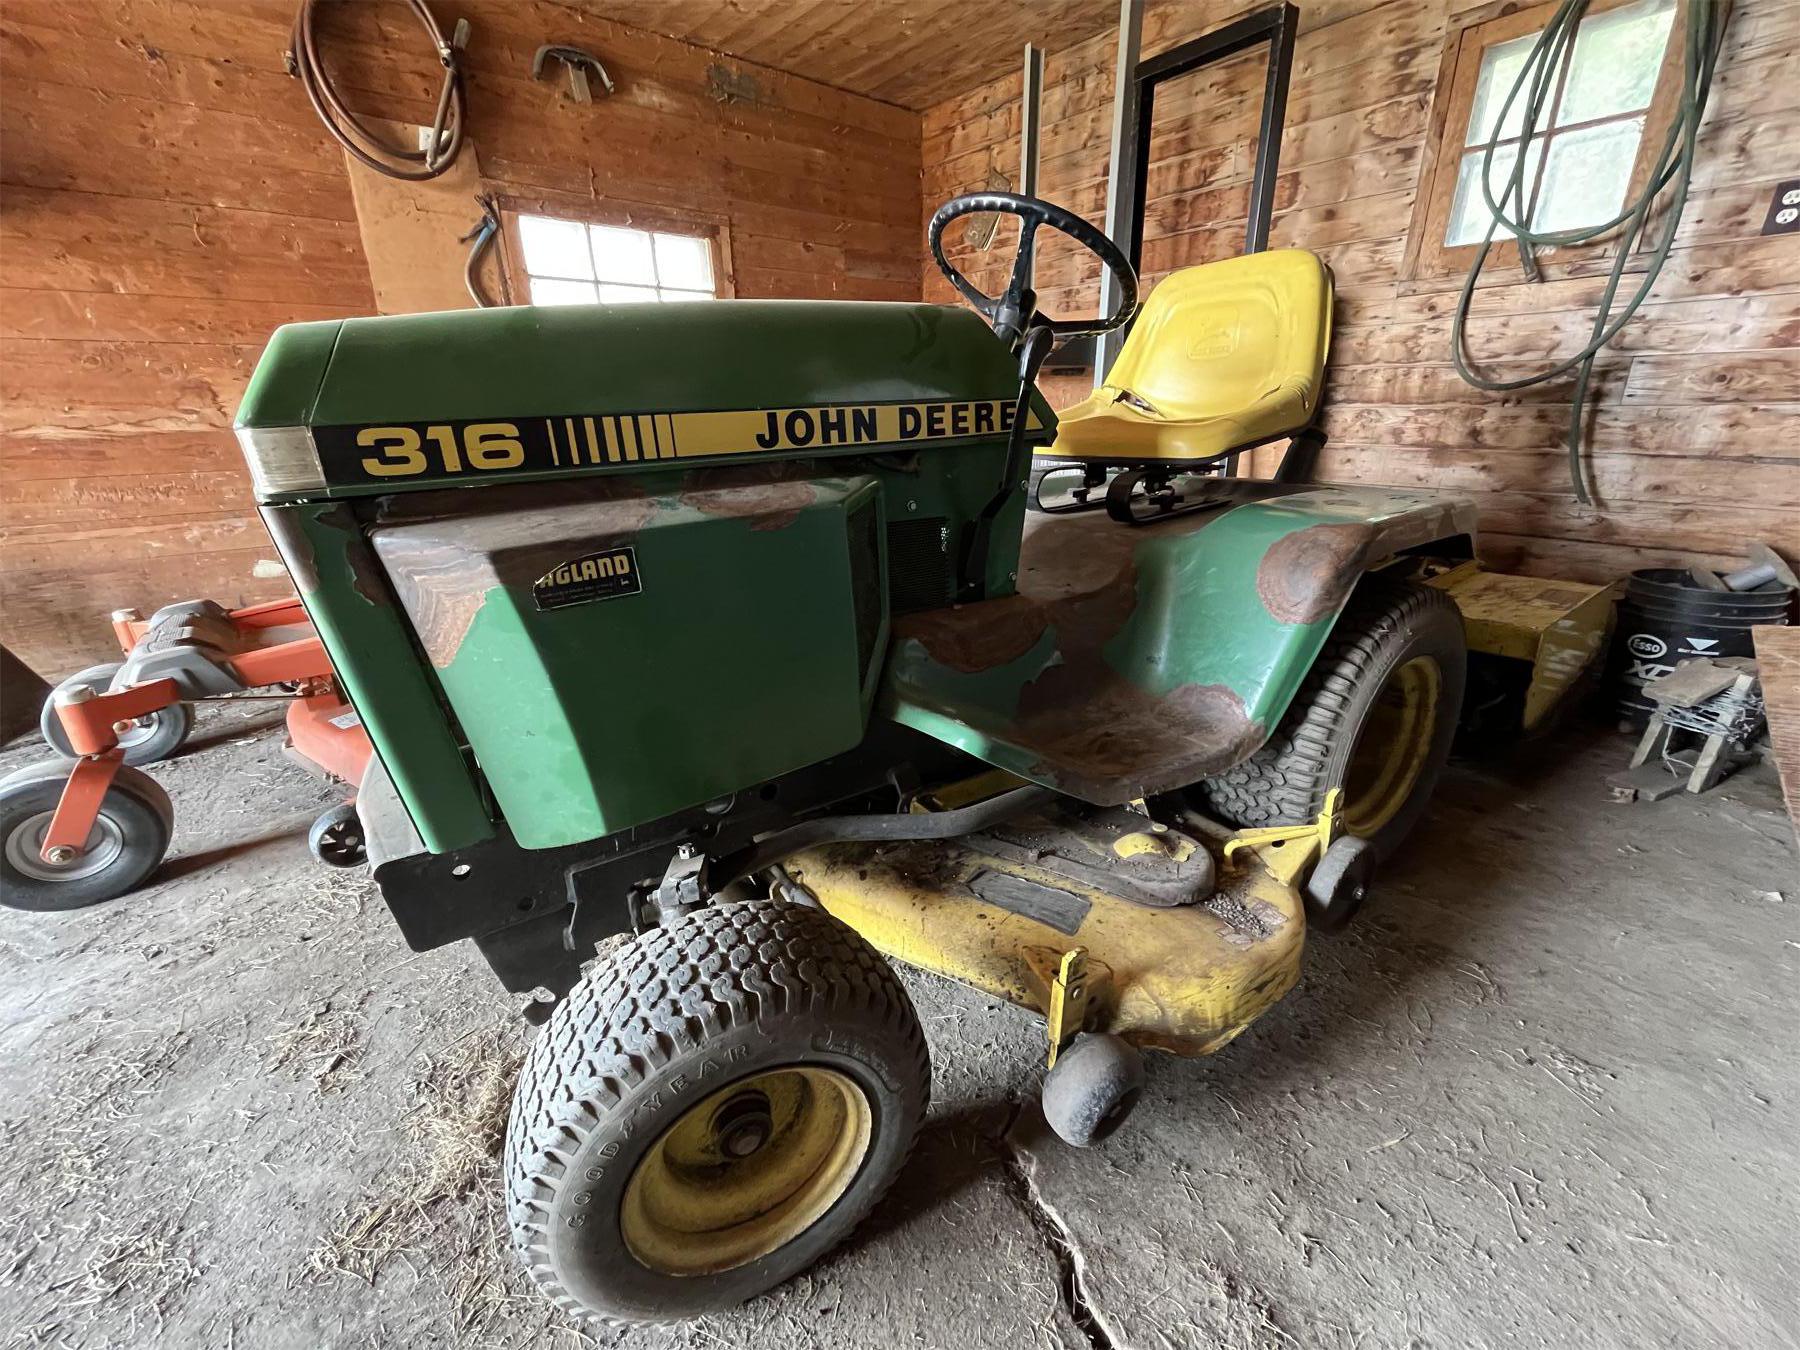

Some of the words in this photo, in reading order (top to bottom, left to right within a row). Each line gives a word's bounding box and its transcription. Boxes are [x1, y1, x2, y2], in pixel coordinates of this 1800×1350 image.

[356, 423, 525, 477] 316
[755, 406, 878, 450] JOHN
[898, 400, 1018, 440] DEERE
[567, 1044, 749, 1231] GOODYEAR
